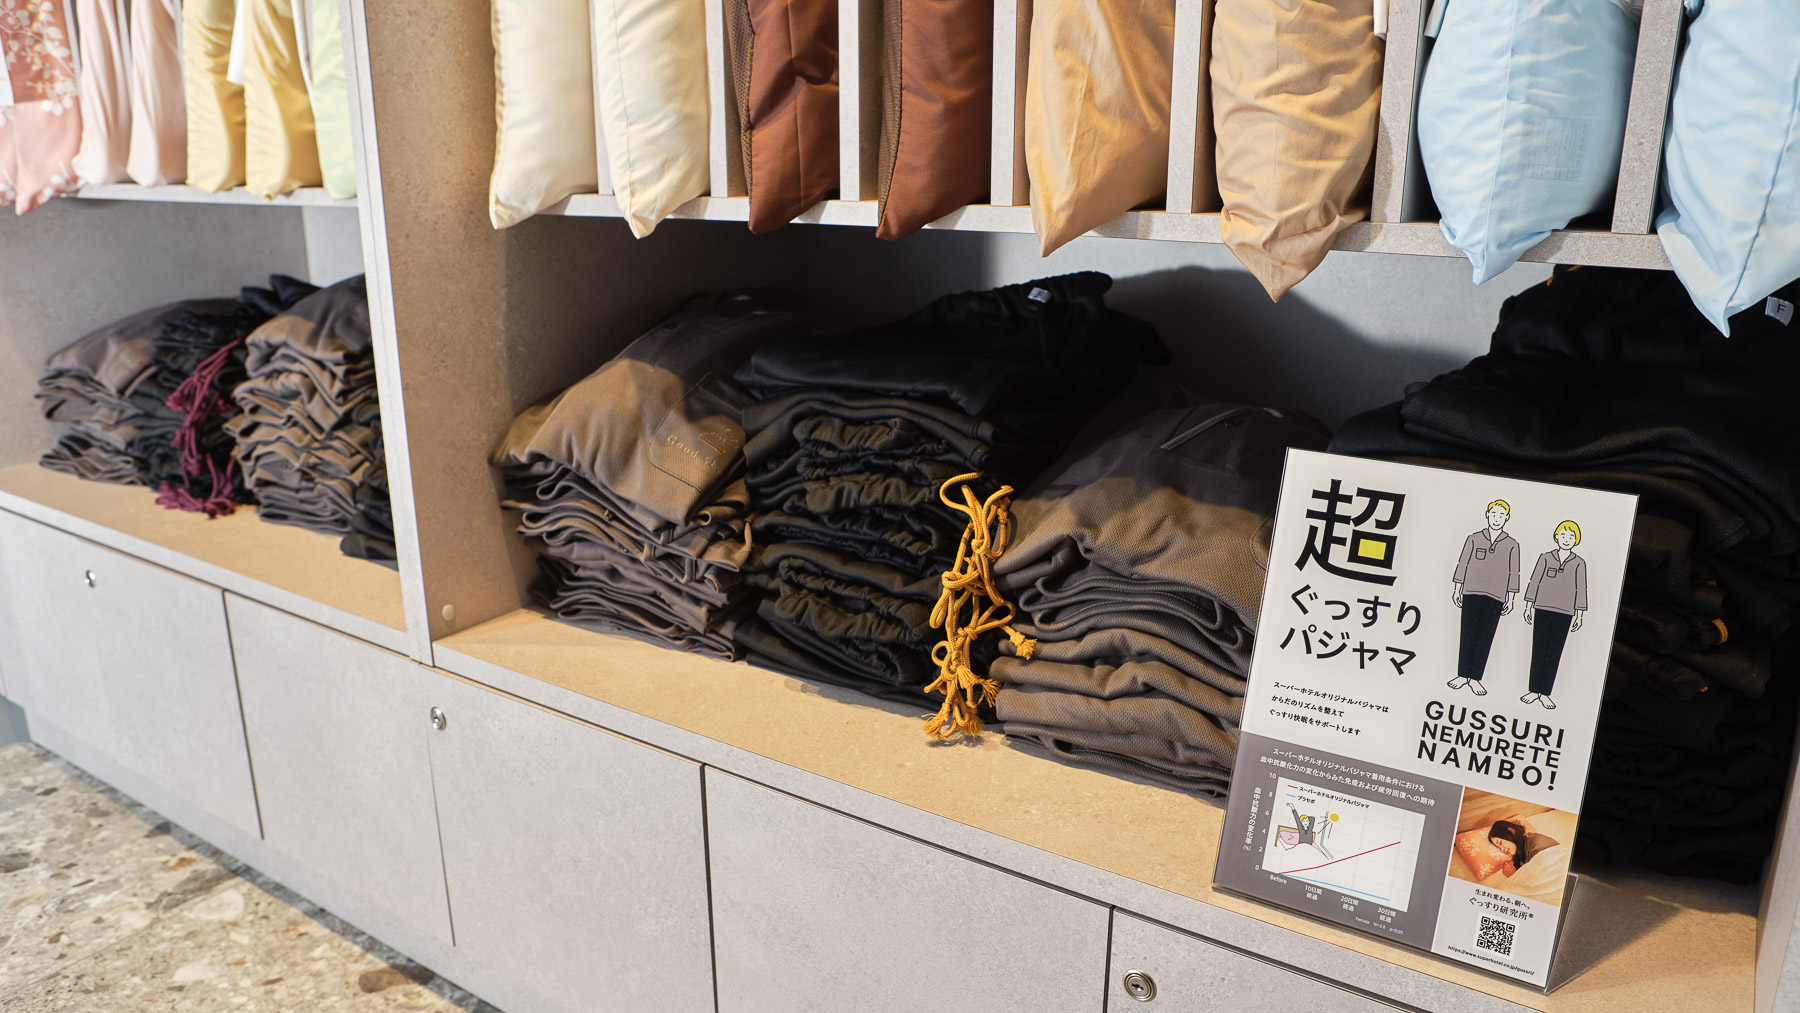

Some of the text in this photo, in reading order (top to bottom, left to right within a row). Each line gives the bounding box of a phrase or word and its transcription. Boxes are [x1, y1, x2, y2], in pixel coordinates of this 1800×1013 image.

[1776, 303, 1787, 313] F
[667, 434, 699, 458] Good
[1294, 478, 1406, 587] 超
[1291, 584, 1421, 636] ぐっすり
[1278, 624, 1417, 676] パジャマ
[1271, 695, 1345, 717] からだのリズムを整えて
[1273, 681, 1389, 713] スーパーホテルオリジナルパジャマは
[1269, 708, 1361, 736] ぐっすり快眠をサポートします
[1425, 700, 1565, 749] GUSSURI
[1421, 721, 1561, 769] NEMURETE
[1273, 748, 1425, 792] スーパーホテルオリジナルパジャマ着用条件における
[1417, 740, 1557, 791] NAMBO!
[1269, 874, 1287, 884] Before
[1305, 885, 1323, 895] 10日間
[1340, 895, 1359, 907] 20日間
[1377, 906, 1397, 918] 30日間
[1475, 888, 1531, 910] 生まれ変わる、朝へ。
